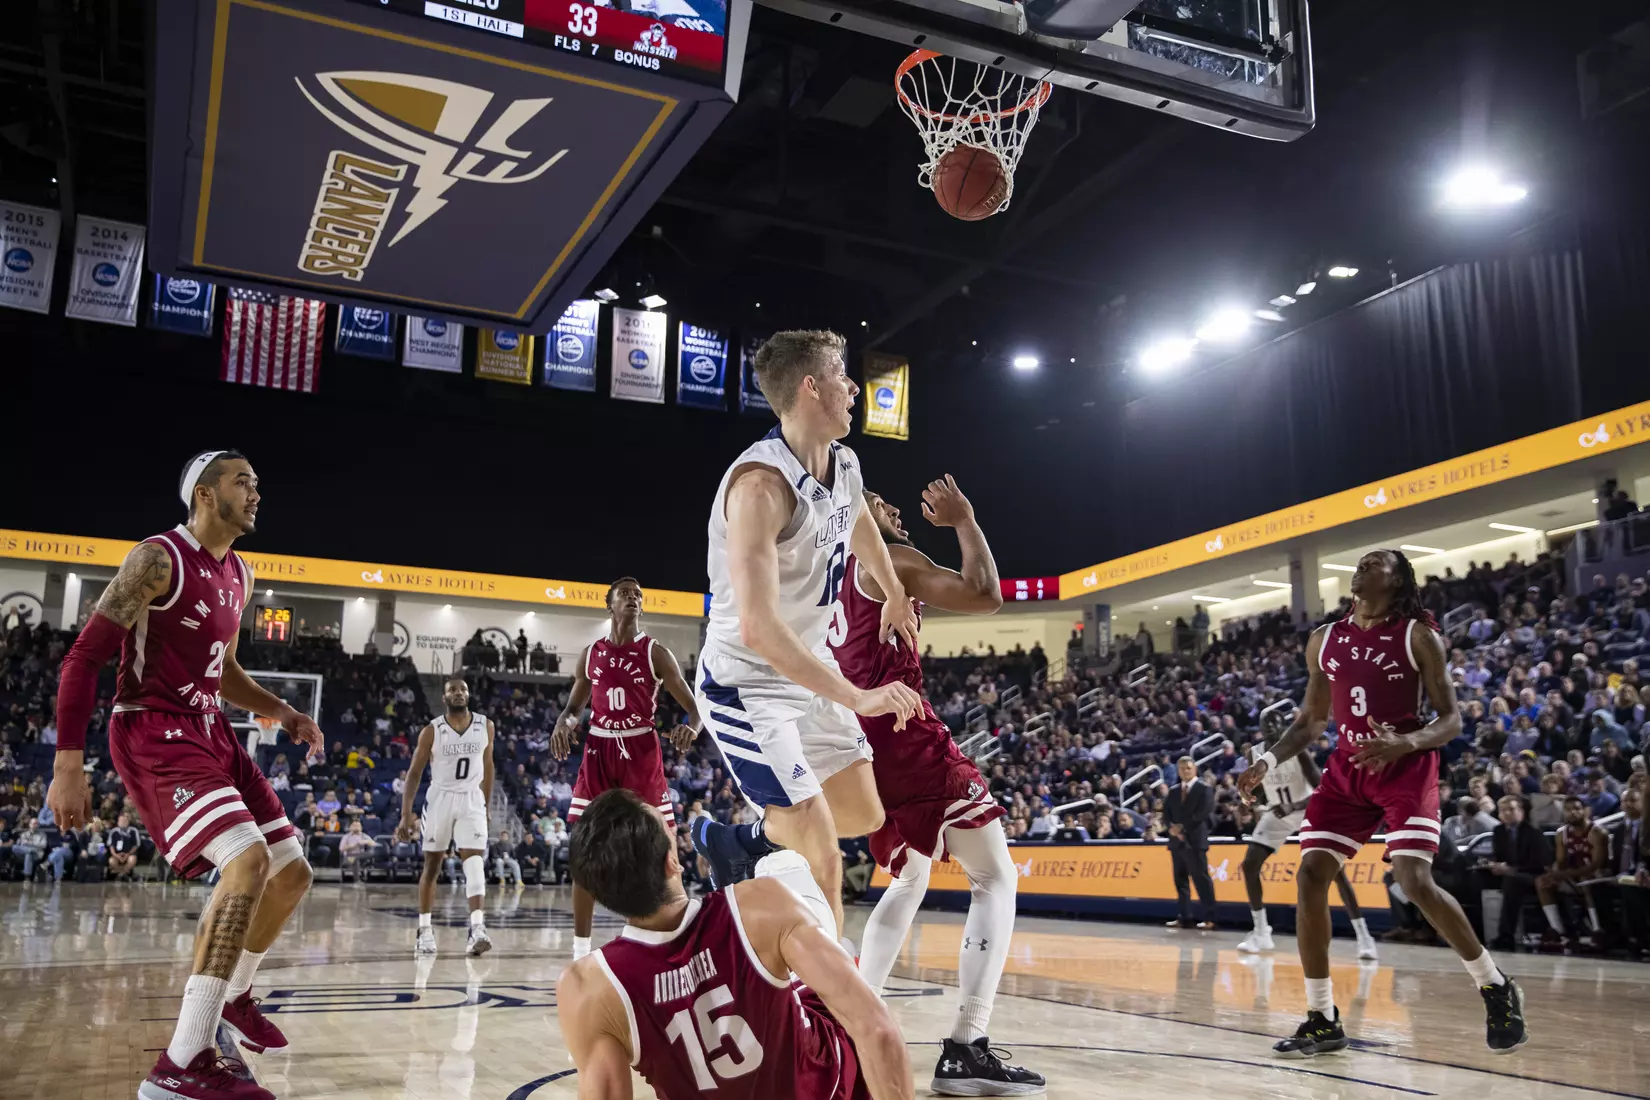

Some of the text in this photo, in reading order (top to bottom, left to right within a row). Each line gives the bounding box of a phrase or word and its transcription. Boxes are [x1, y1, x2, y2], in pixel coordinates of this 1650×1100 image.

[442, 8, 510, 32] 1ST HALF
[567, 2, 598, 37] 33
[554, 34, 660, 70] FLS 7 BONUS
[4, 210, 45, 228] 2015
[297, 150, 408, 282] LANCERS
[6, 225, 39, 238] MEN'S
[90, 226, 129, 243] 2014
[0, 233, 53, 250] ASKETBALL
[92, 241, 124, 252] MEN'S
[152, 301, 209, 320] CHAMPIONS
[340, 328, 394, 345] CHAMPIONS
[689, 325, 719, 341] 2017
[684, 335, 722, 351] WOMEN'S
[409, 346, 457, 359] CHAMPIONS
[544, 361, 593, 376] CHAMPIONS
[680, 381, 725, 396] CHAMPIONS
[1390, 453, 1510, 500] AYRES HOTELS
[1224, 510, 1316, 548] AYRES HOTELS
[25, 540, 96, 557] HOTELS
[387, 574, 496, 593] AYRES HOTELS
[568, 589, 600, 601] AYR
[266, 621, 285, 640] 17
[416, 634, 458, 644] EQUIPPED
[416, 642, 456, 652] TO SERVE
[609, 657, 645, 685] STATE
[1351, 646, 1404, 681] STATE
[605, 686, 627, 711] 10
[1350, 686, 1367, 717] 3
[598, 713, 642, 730] AGGIES
[442, 743, 481, 757] LANCERS
[455, 757, 470, 780] 0
[1275, 786, 1293, 804] 11
[1031, 860, 1077, 877] AYRES
[1079, 861, 1141, 879] HOTELS
[1228, 861, 1296, 882] ARES
[664, 983, 764, 1091] 15
